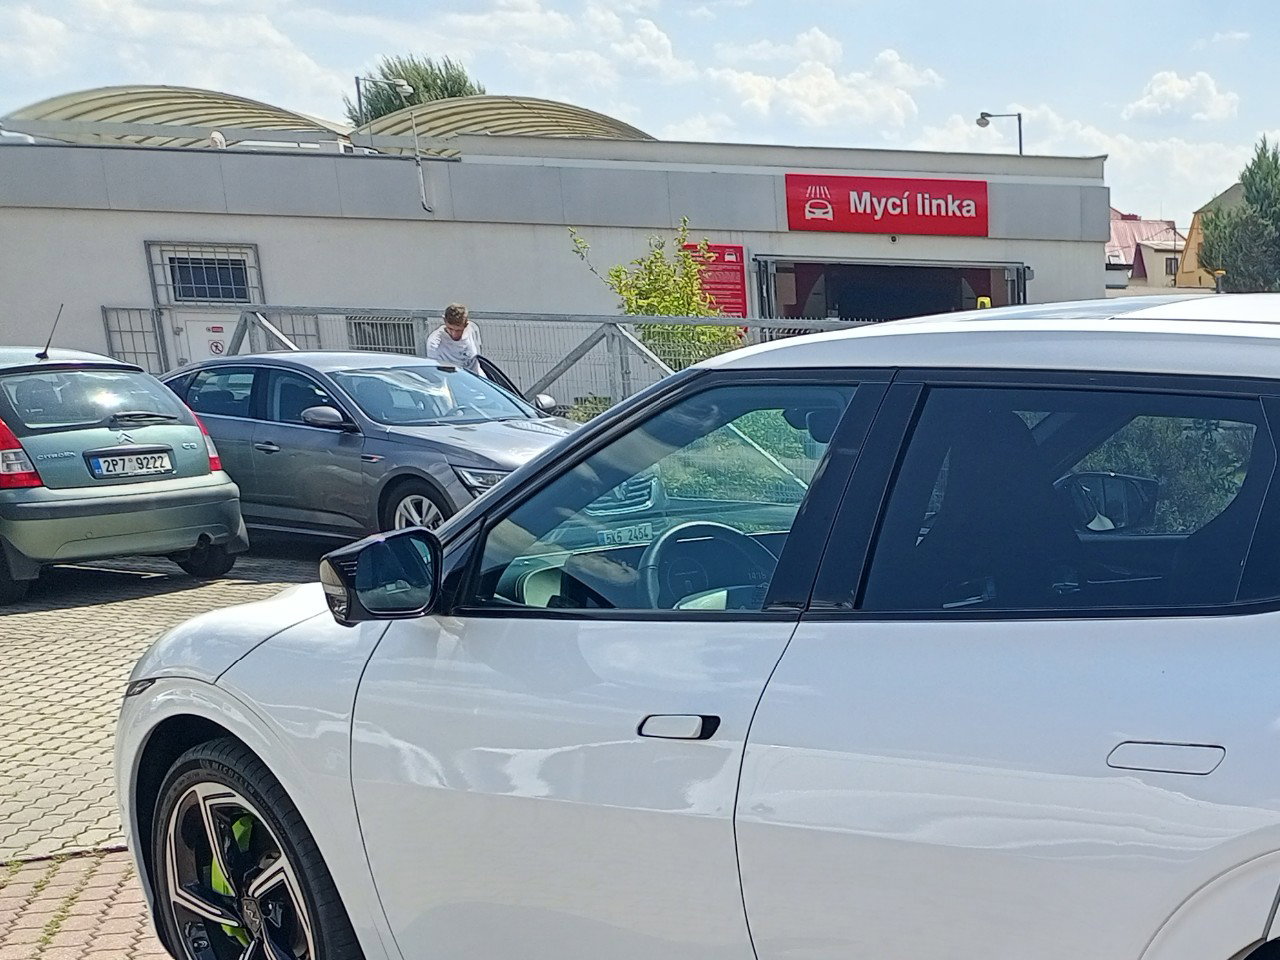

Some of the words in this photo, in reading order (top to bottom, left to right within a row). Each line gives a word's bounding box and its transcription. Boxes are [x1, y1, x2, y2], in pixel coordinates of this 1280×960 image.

[850, 190, 910, 221] Mycí
[916, 192, 977, 218] linka
[103, 458, 126, 473] 2P7
[136, 455, 166, 470] 9222
